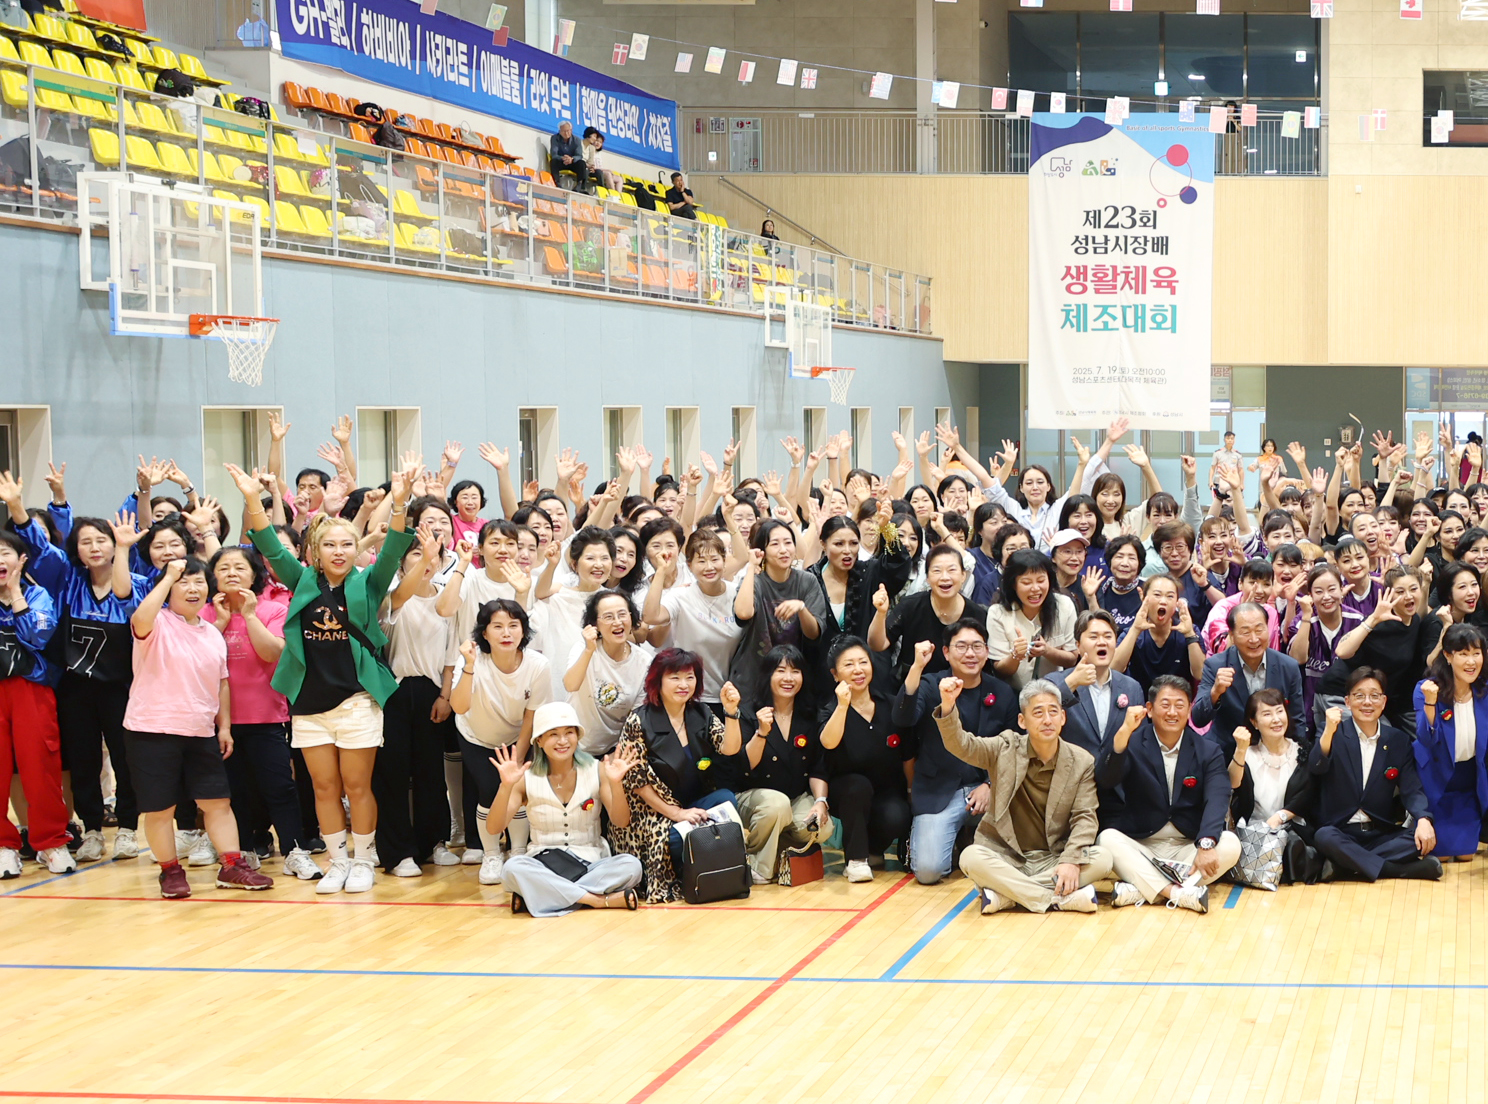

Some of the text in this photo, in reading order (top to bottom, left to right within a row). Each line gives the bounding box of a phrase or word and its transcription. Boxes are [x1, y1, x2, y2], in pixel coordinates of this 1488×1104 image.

[551, 75, 571, 120] 무브
[581, 85, 607, 134] 한마음
[607, 96, 640, 144] 댄싱라인
[1083, 205, 1158, 230] 제23회
[1071, 234, 1169, 256] 성남시장배
[1061, 265, 1179, 296] 생활체육
[1060, 303, 1177, 334] 체조대회
[67, 624, 107, 678] 7
